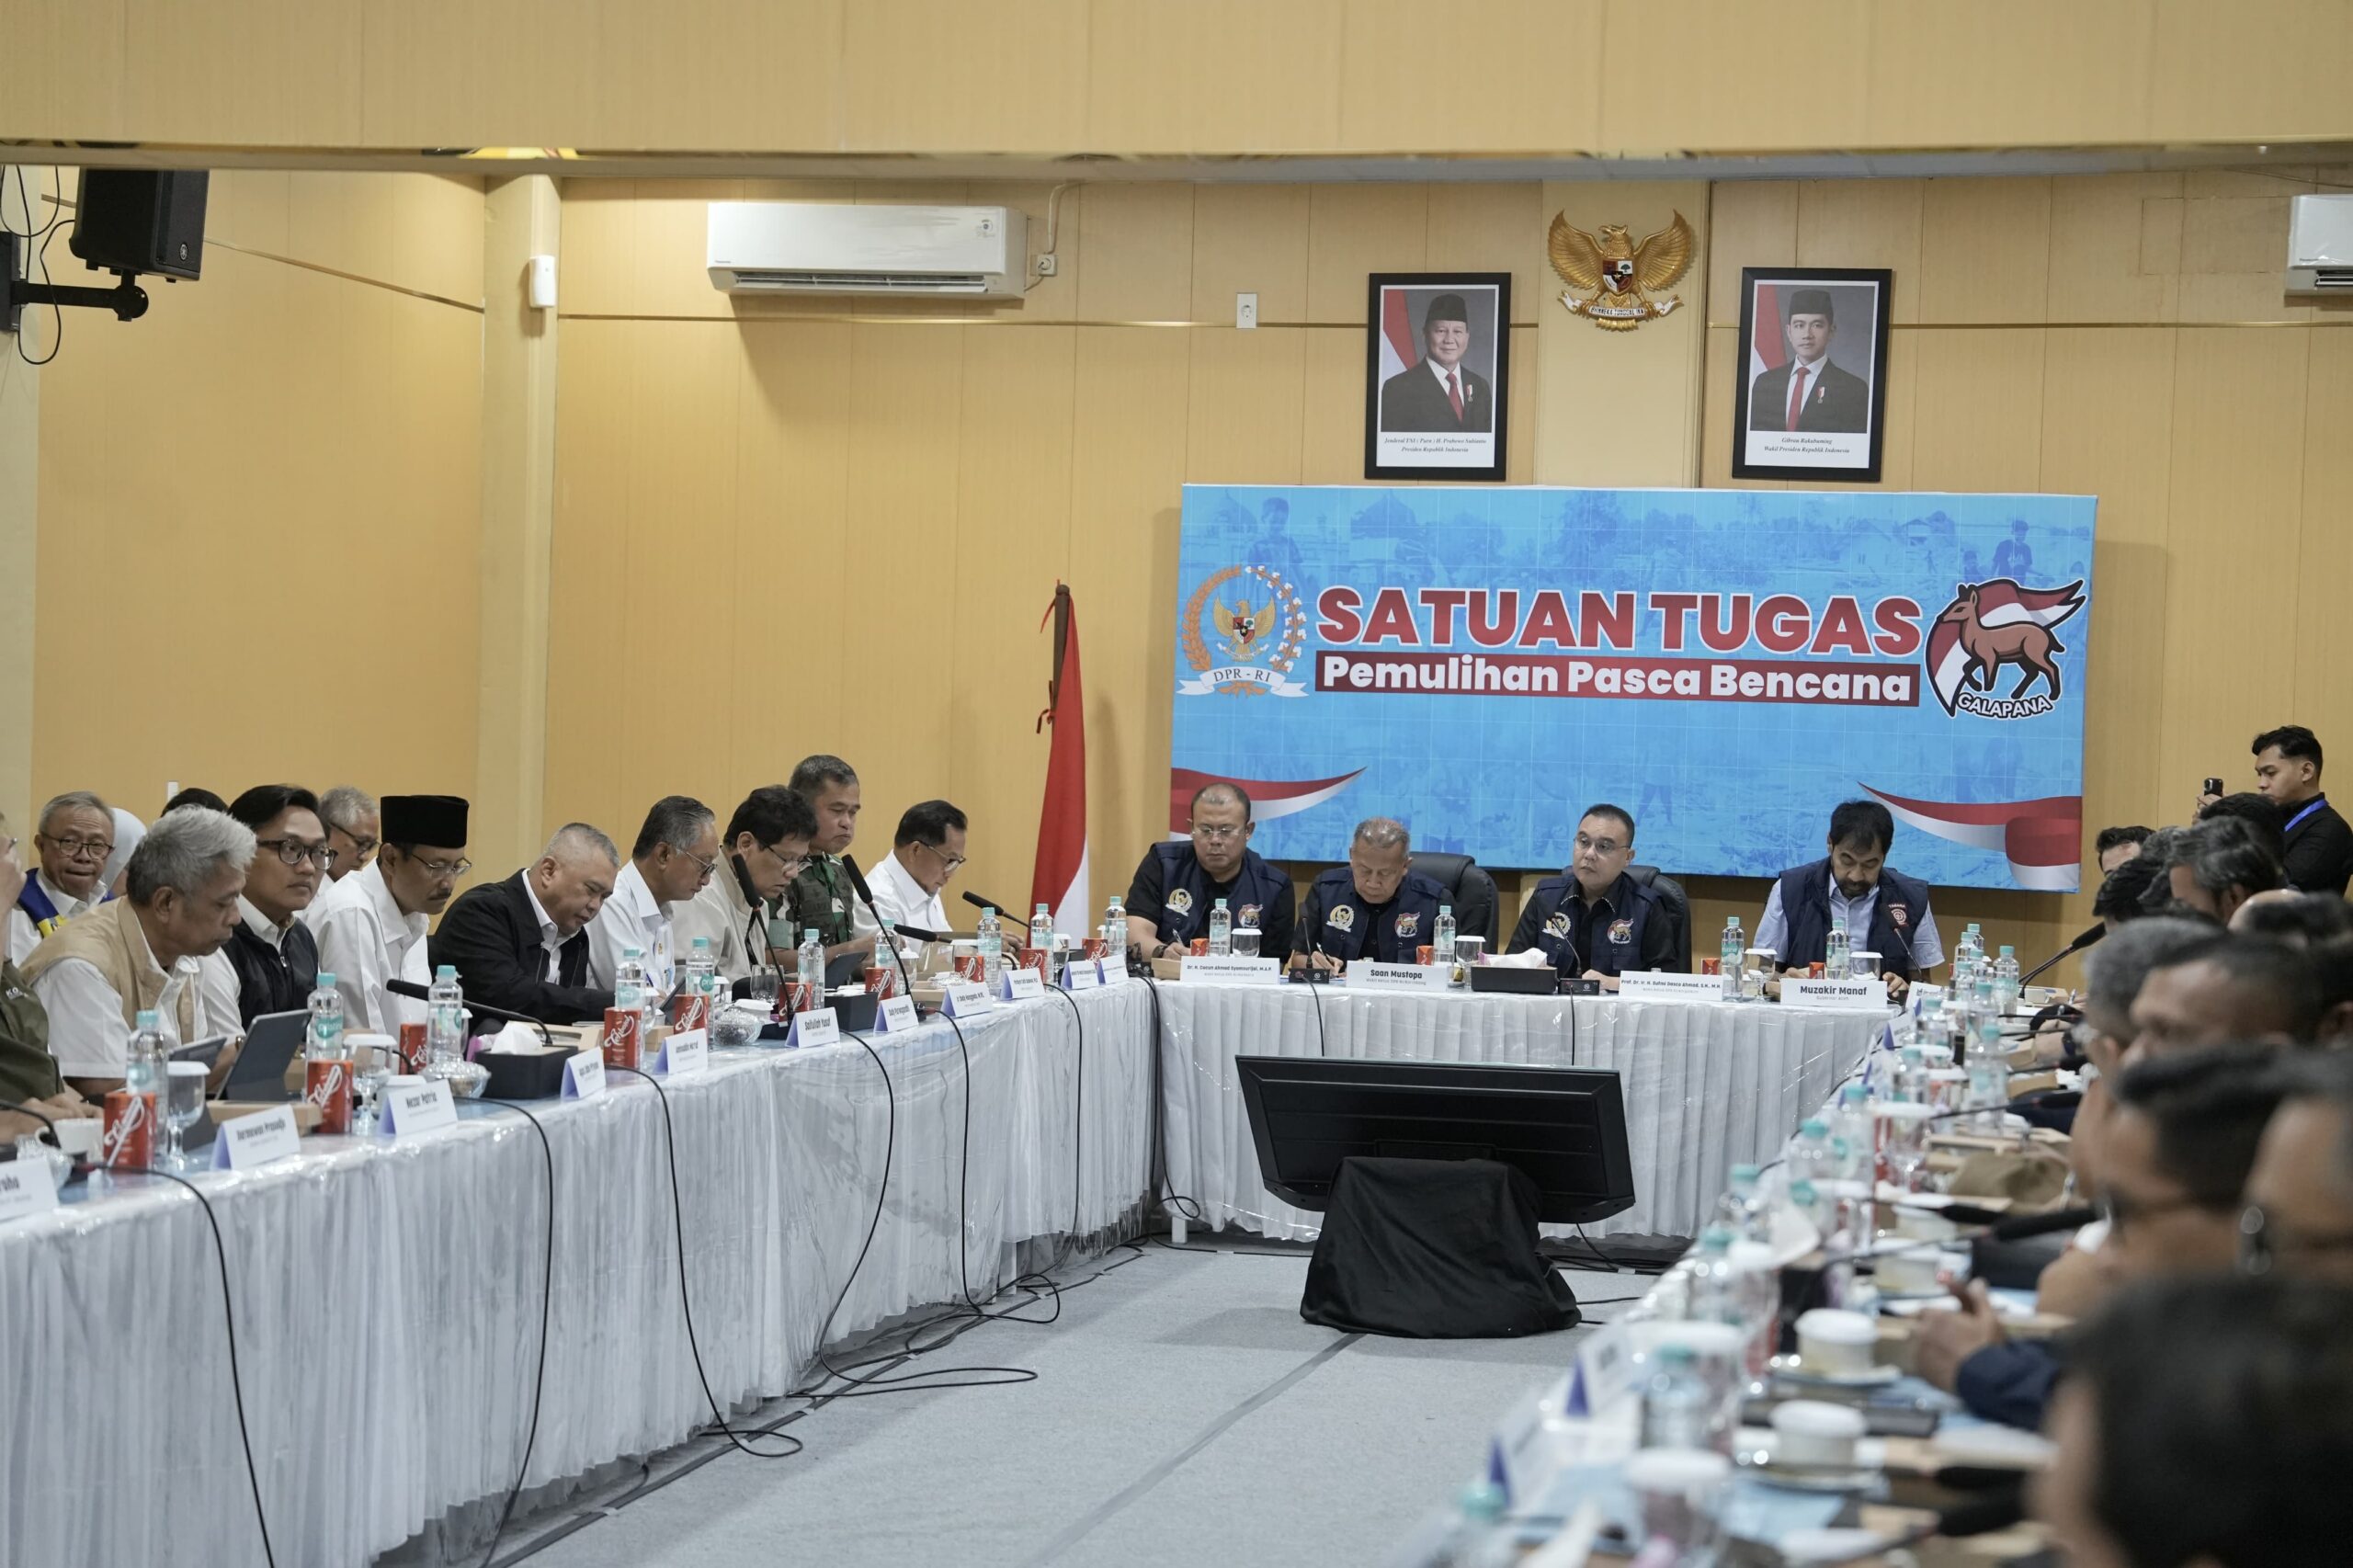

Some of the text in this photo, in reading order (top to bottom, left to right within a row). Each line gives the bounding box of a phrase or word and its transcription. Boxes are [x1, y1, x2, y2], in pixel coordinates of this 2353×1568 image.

[1316, 585, 1922, 657] SATUAN TUGAS
[1324, 653, 1911, 701] Pemulihan Pasca Bencana
[1958, 693, 2052, 717] GALAPANA
[1370, 969, 1423, 980] Saan Mustopa
[1800, 985, 1867, 995] Muzakir Manaf
